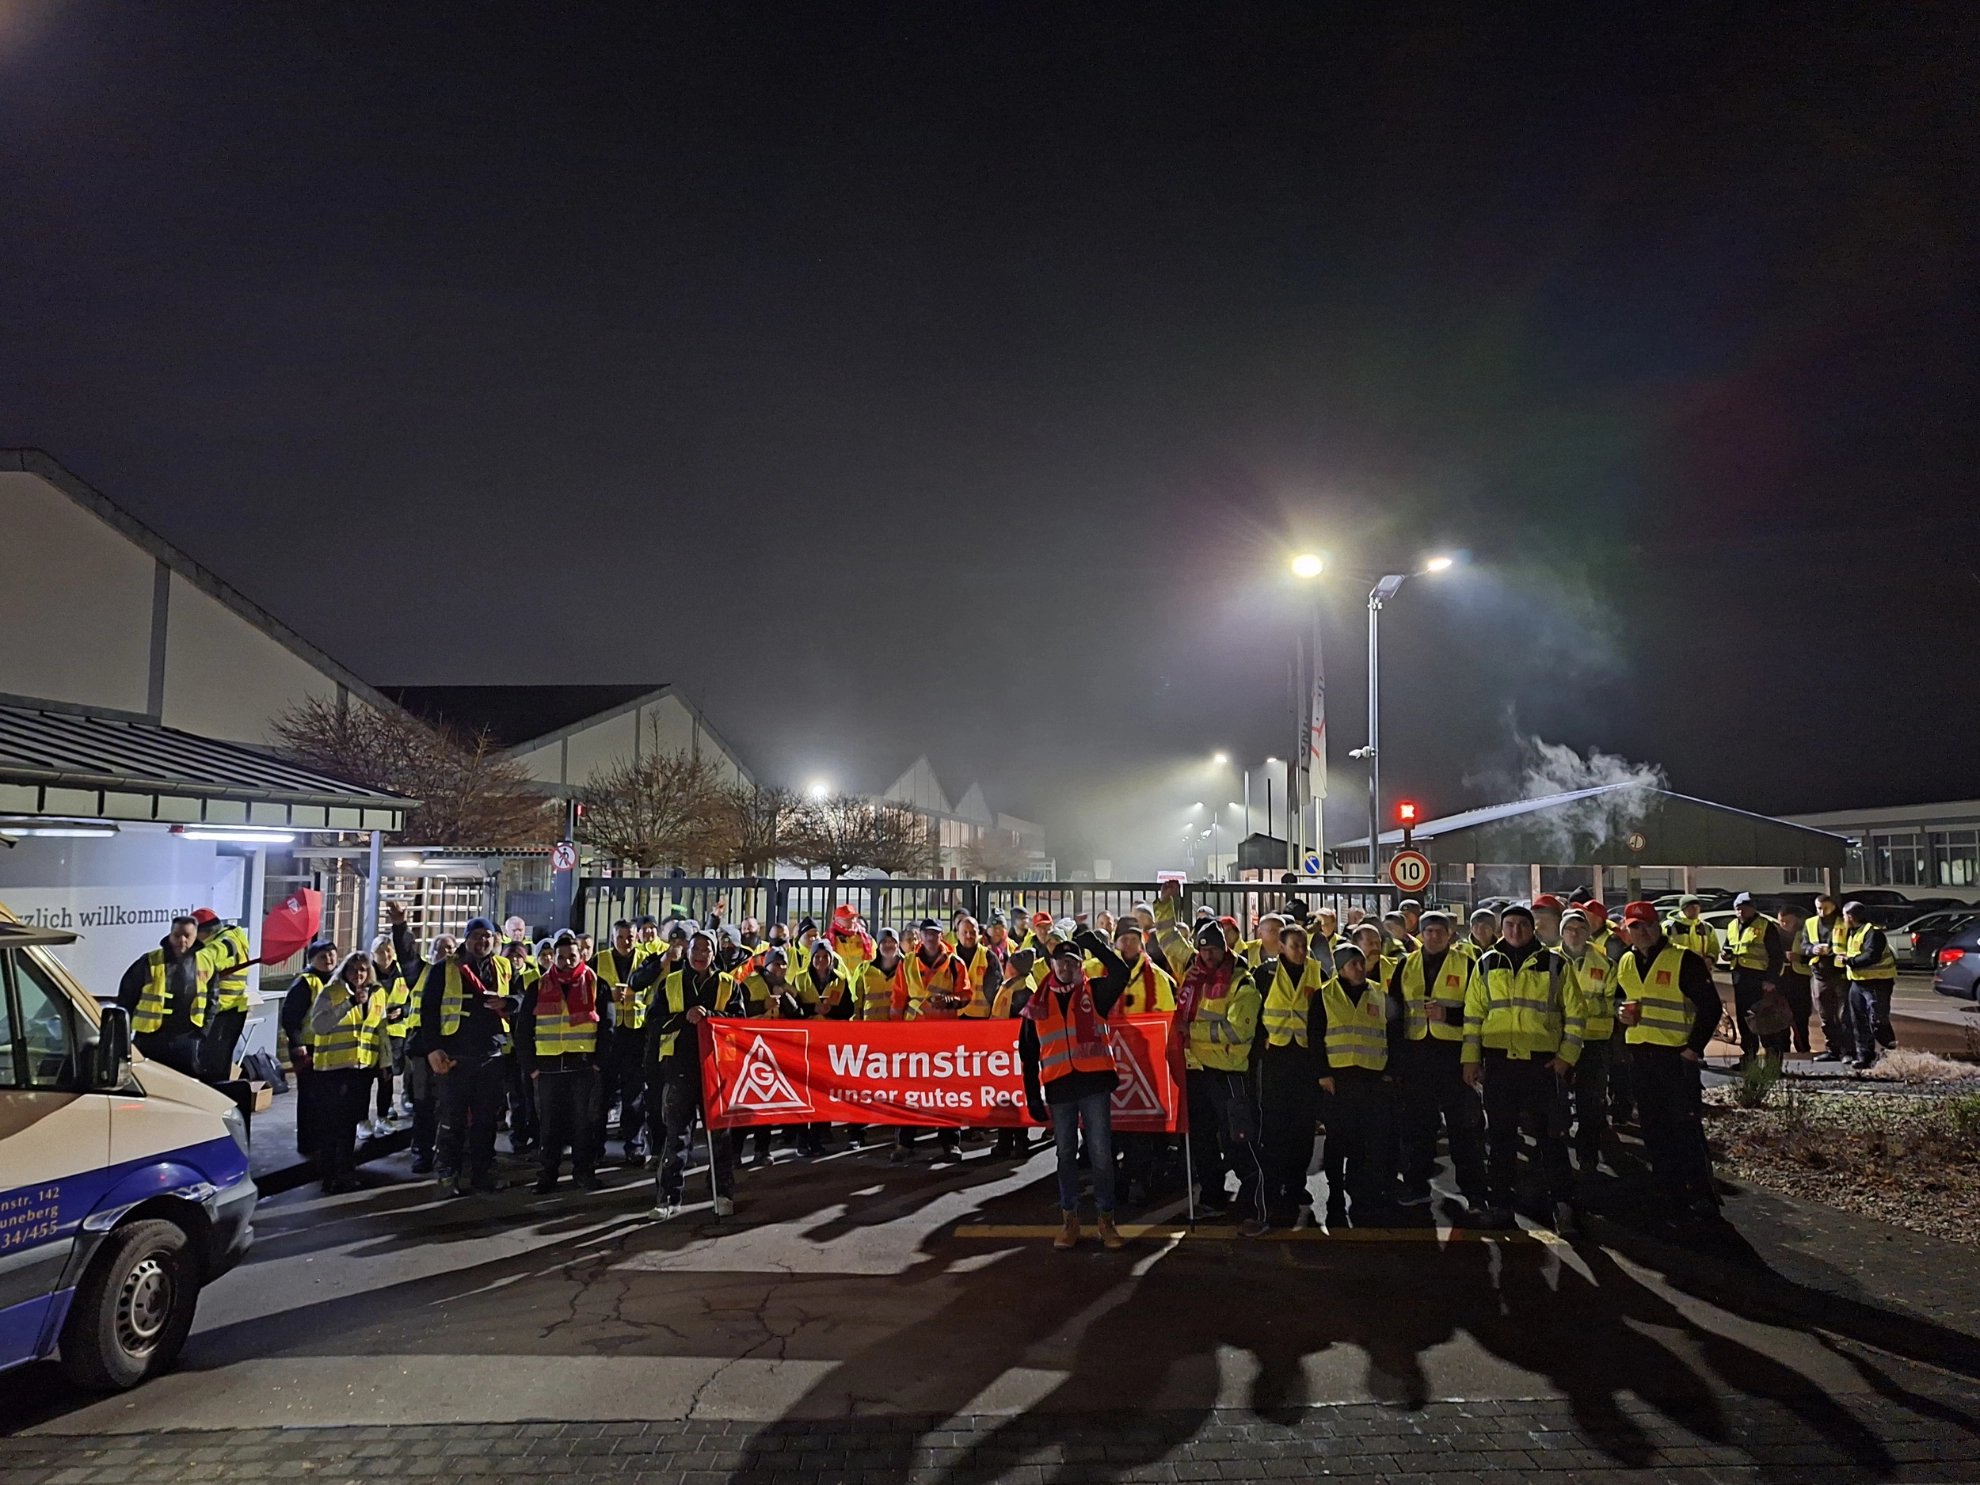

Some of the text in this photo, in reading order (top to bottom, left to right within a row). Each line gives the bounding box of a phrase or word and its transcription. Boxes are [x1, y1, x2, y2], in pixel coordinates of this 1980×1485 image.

[1401, 862, 1420, 880] 10
[17, 908, 73, 928] zlich
[828, 1040, 1023, 1079] Warnstrei
[829, 1086, 1028, 1108] unser gutes Rec
[39, 1187, 60, 1202] 142
[1, 1220, 58, 1249] 34/455
